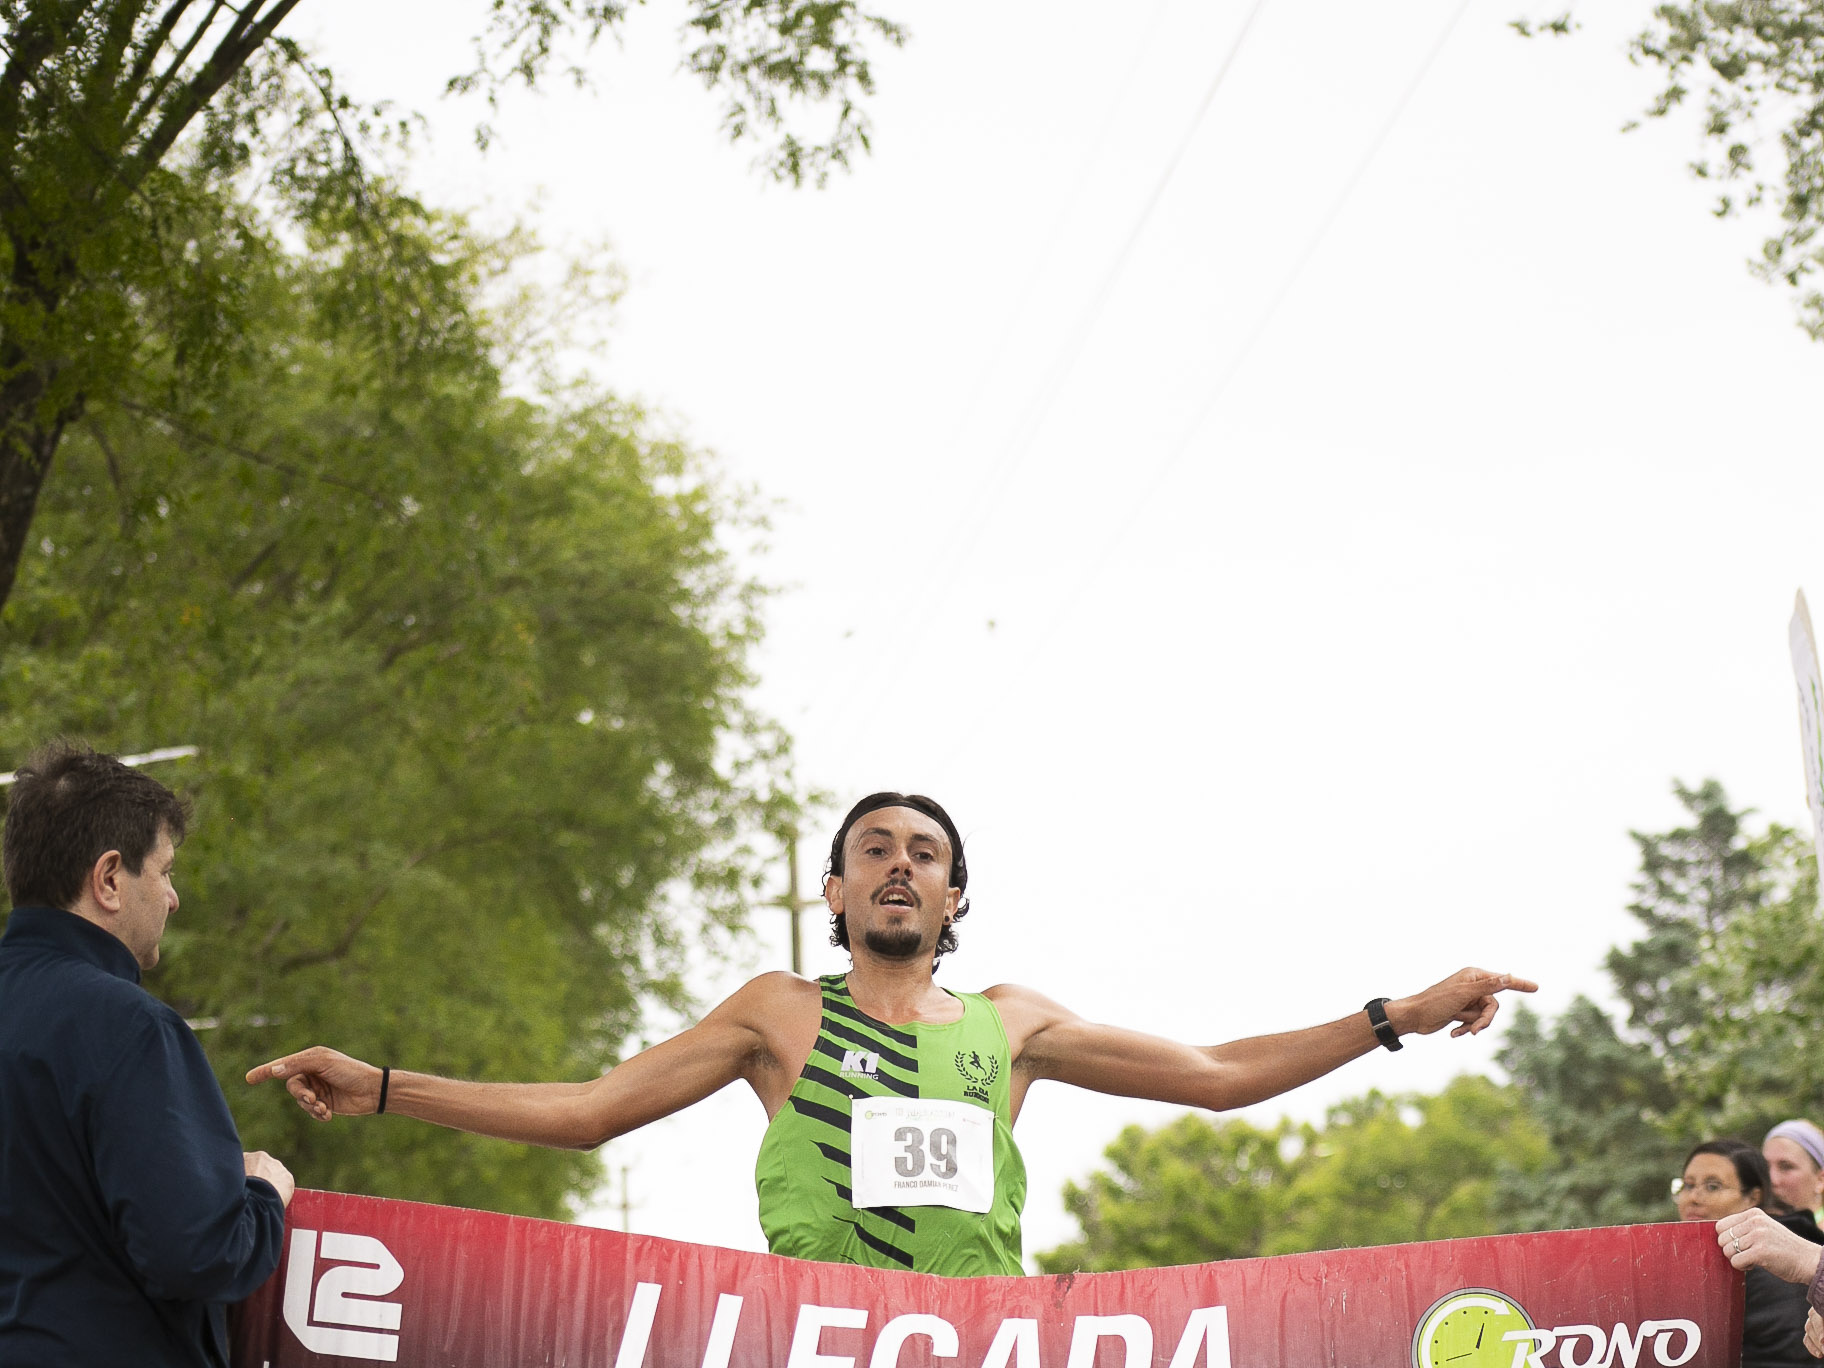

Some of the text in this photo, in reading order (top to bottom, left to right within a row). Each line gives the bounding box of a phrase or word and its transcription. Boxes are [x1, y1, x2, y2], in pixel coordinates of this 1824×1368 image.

[841, 1050, 879, 1073] K1
[840, 1072, 879, 1080] RUNNING
[894, 1126, 958, 1179] 39
[894, 1180, 918, 1189] FRANCO
